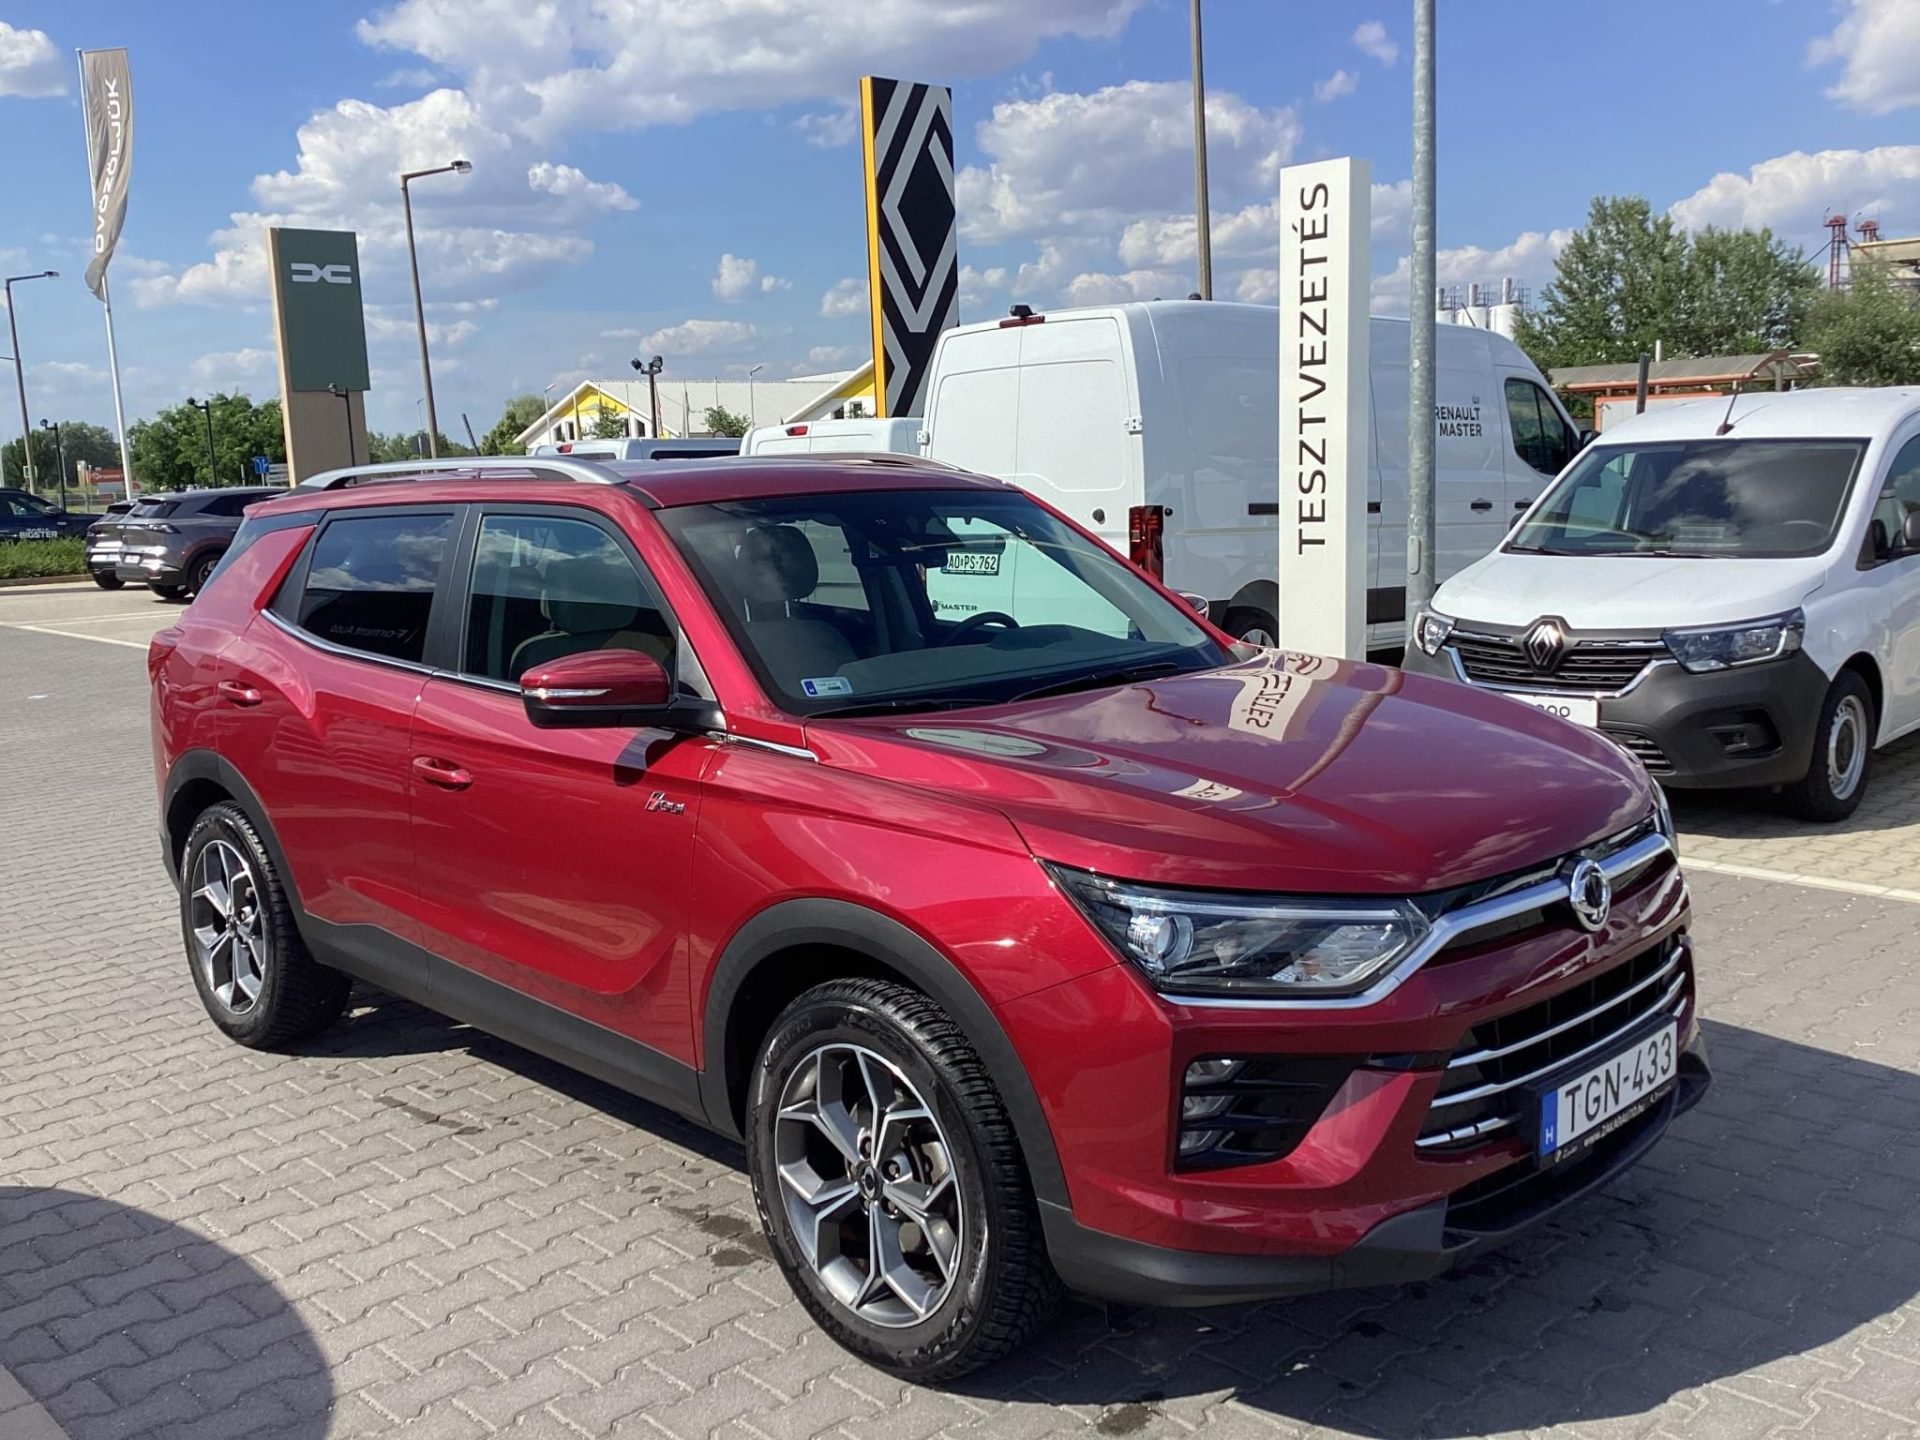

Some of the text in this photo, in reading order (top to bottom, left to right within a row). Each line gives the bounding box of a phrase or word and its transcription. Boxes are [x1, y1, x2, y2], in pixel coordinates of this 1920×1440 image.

[95, 77, 122, 254] DVÖZÖLJÜK
[1291, 181, 1330, 556] TESZTVEZETÉS
[1434, 406, 1480, 421] RENAULT
[1439, 422, 1483, 437] MASTER
[19, 530, 58, 539] BIGSTER
[964, 555, 996, 570] PS-762
[941, 602, 978, 612] MASTER
[1545, 1031, 1672, 1145] H TGN-433
